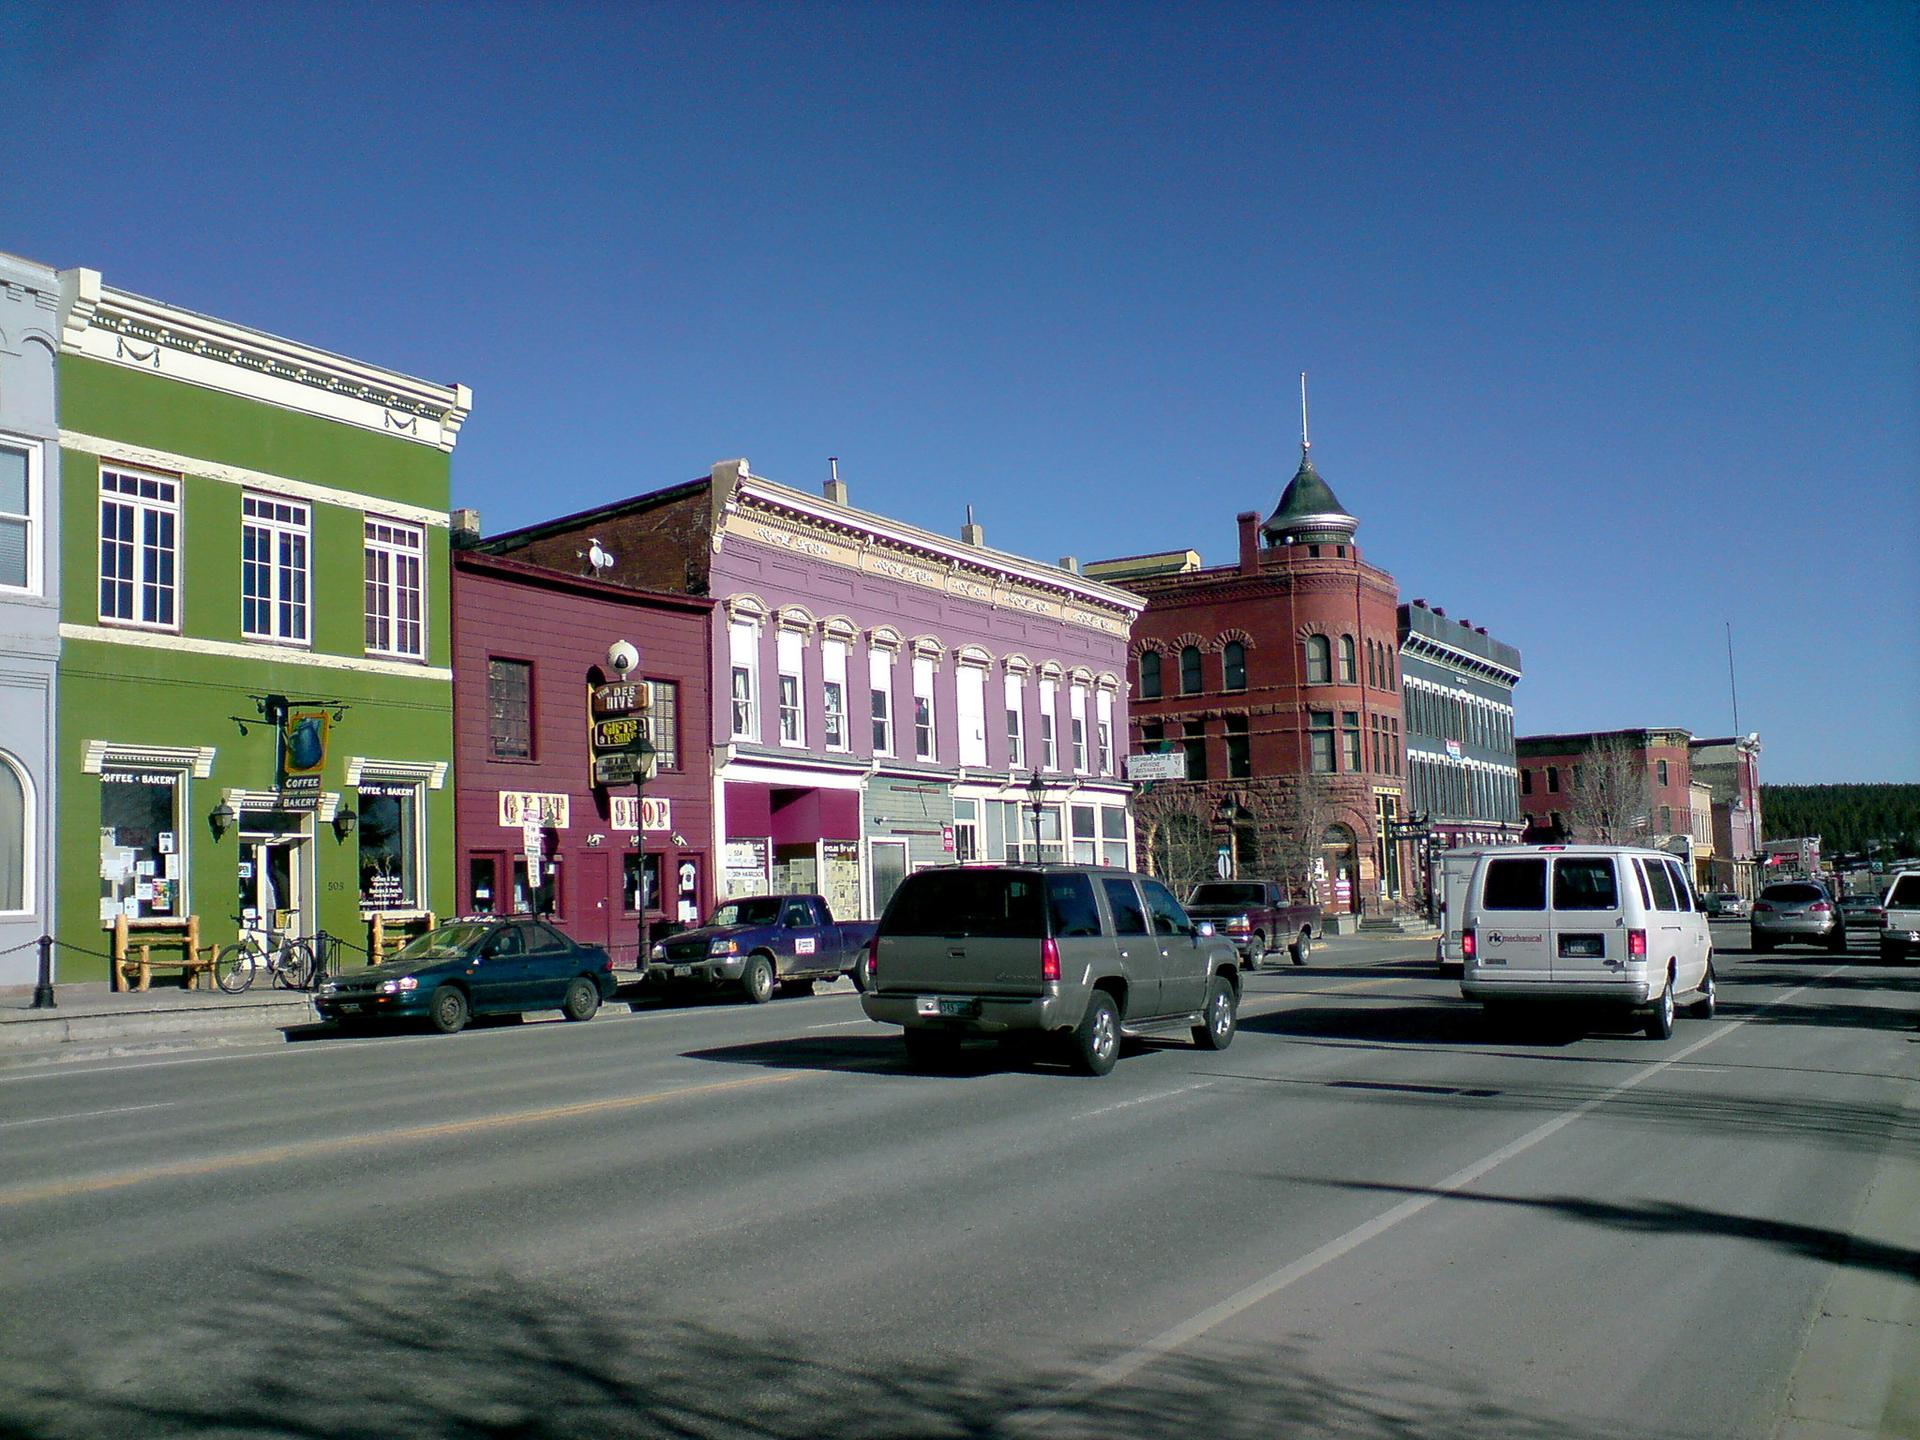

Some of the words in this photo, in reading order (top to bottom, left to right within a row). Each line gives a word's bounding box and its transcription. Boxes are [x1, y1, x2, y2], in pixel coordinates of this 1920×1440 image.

[603, 721, 638, 735] GIFTS
[141, 775, 177, 785] BAKERY
[285, 779, 319, 788] COFFEE
[358, 786, 381, 795] OFFEE
[387, 788, 414, 796] BAKERY
[283, 798, 317, 807] BAKERY
[504, 794, 564, 825] GIFT
[616, 799, 667, 828] SHOP
[1502, 933, 1542, 943] mechanical
